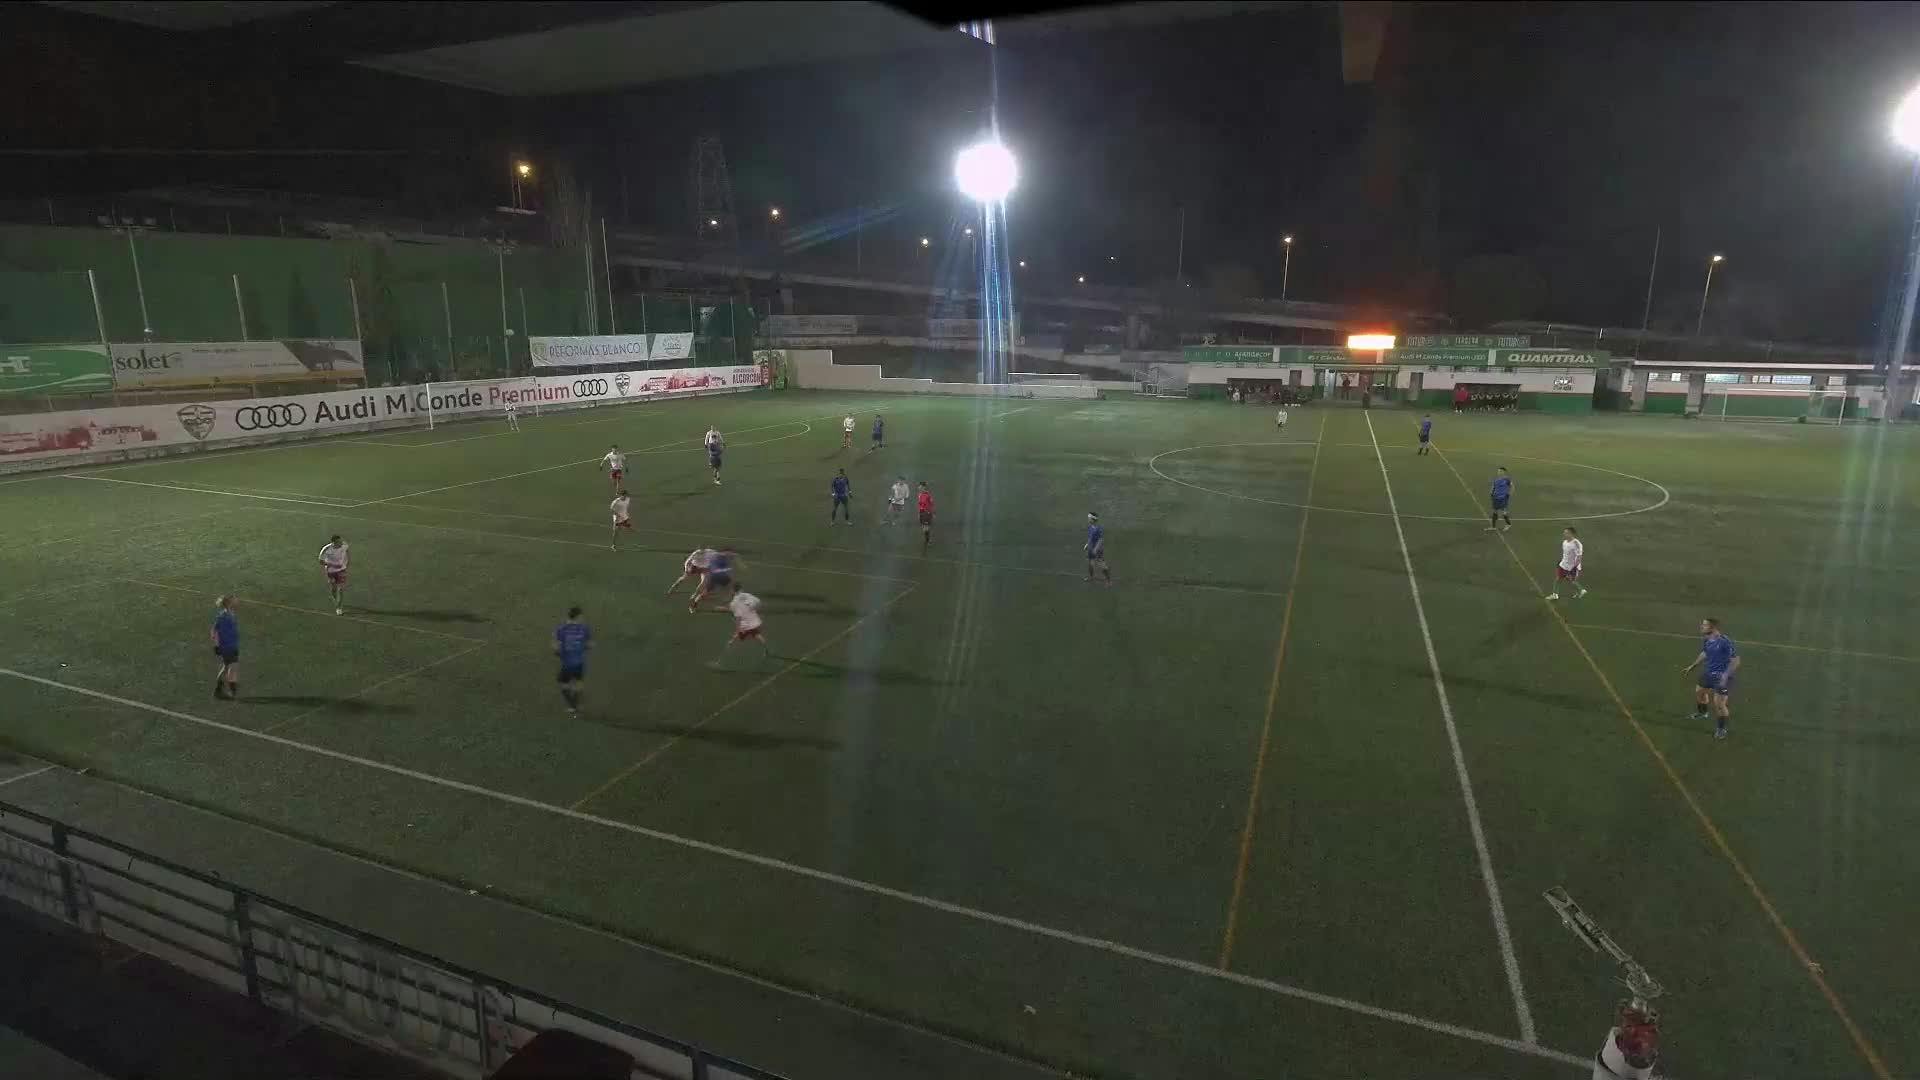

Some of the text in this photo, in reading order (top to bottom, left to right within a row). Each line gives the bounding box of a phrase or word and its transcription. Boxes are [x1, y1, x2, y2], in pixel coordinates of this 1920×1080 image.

[550, 342, 640, 358] REFORMAS BLANCO
[1508, 353, 1597, 364] QUAMTRAX
[315, 396, 375, 423] Audi
[489, 384, 570, 406] Premium
